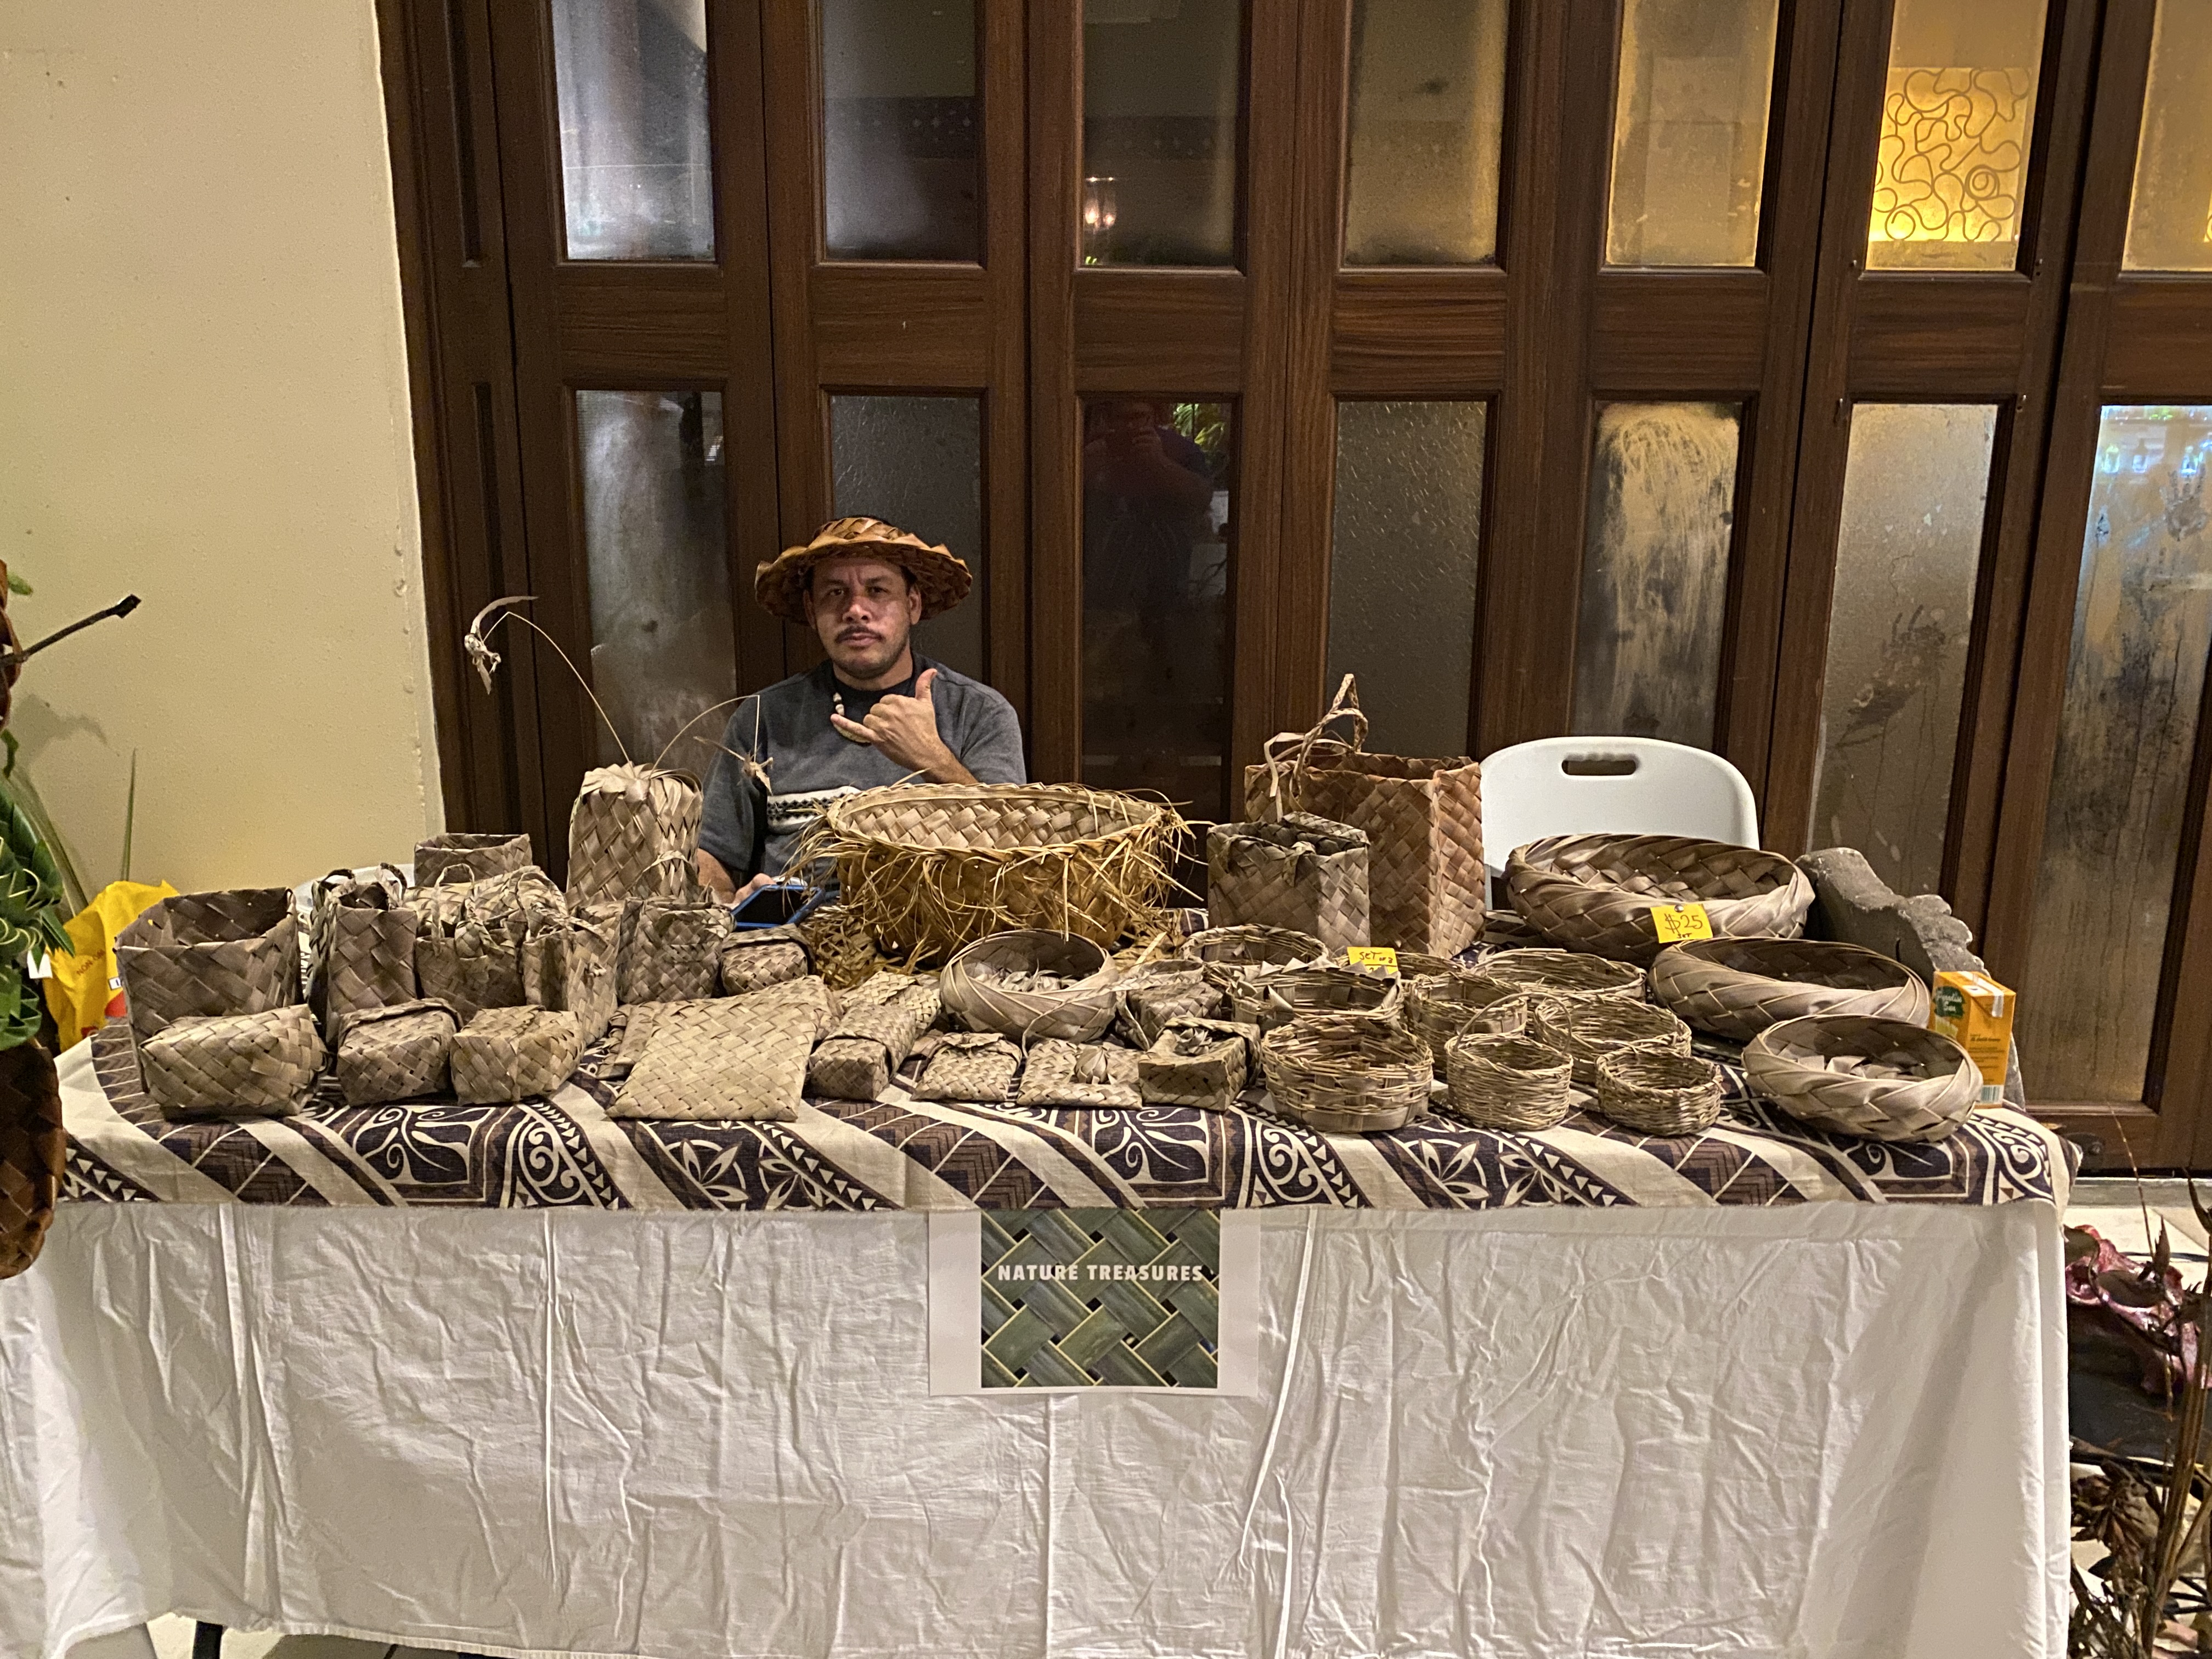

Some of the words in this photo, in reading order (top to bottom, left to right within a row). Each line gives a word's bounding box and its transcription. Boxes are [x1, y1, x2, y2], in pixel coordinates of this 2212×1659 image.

[1664, 913, 1703, 934] $25
[1359, 951, 1383, 960] SET
[997, 1265, 1079, 1281] NATURE
[1086, 1265, 1203, 1282] TREASURES
